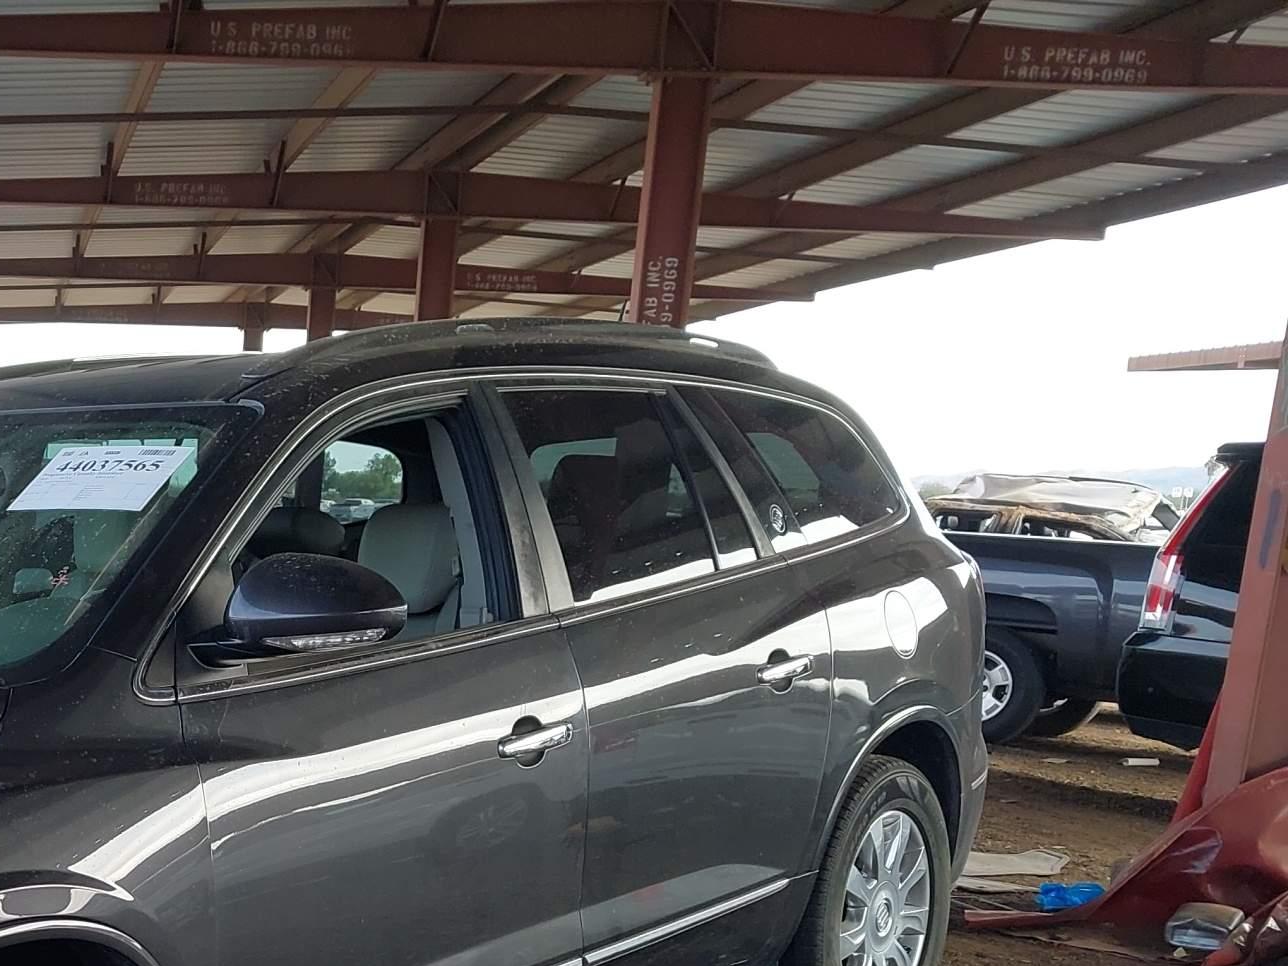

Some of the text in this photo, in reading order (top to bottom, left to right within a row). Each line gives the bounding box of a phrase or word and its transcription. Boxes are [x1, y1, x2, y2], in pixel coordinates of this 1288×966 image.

[251, 22, 318, 40] PREFAB
[1044, 47, 1112, 65] PREFAB
[1118, 49, 1152, 66] INC.
[646, 255, 663, 288] INC.
[659, 257, 679, 327] 9-0969
[56, 459, 165, 472] 44037565
